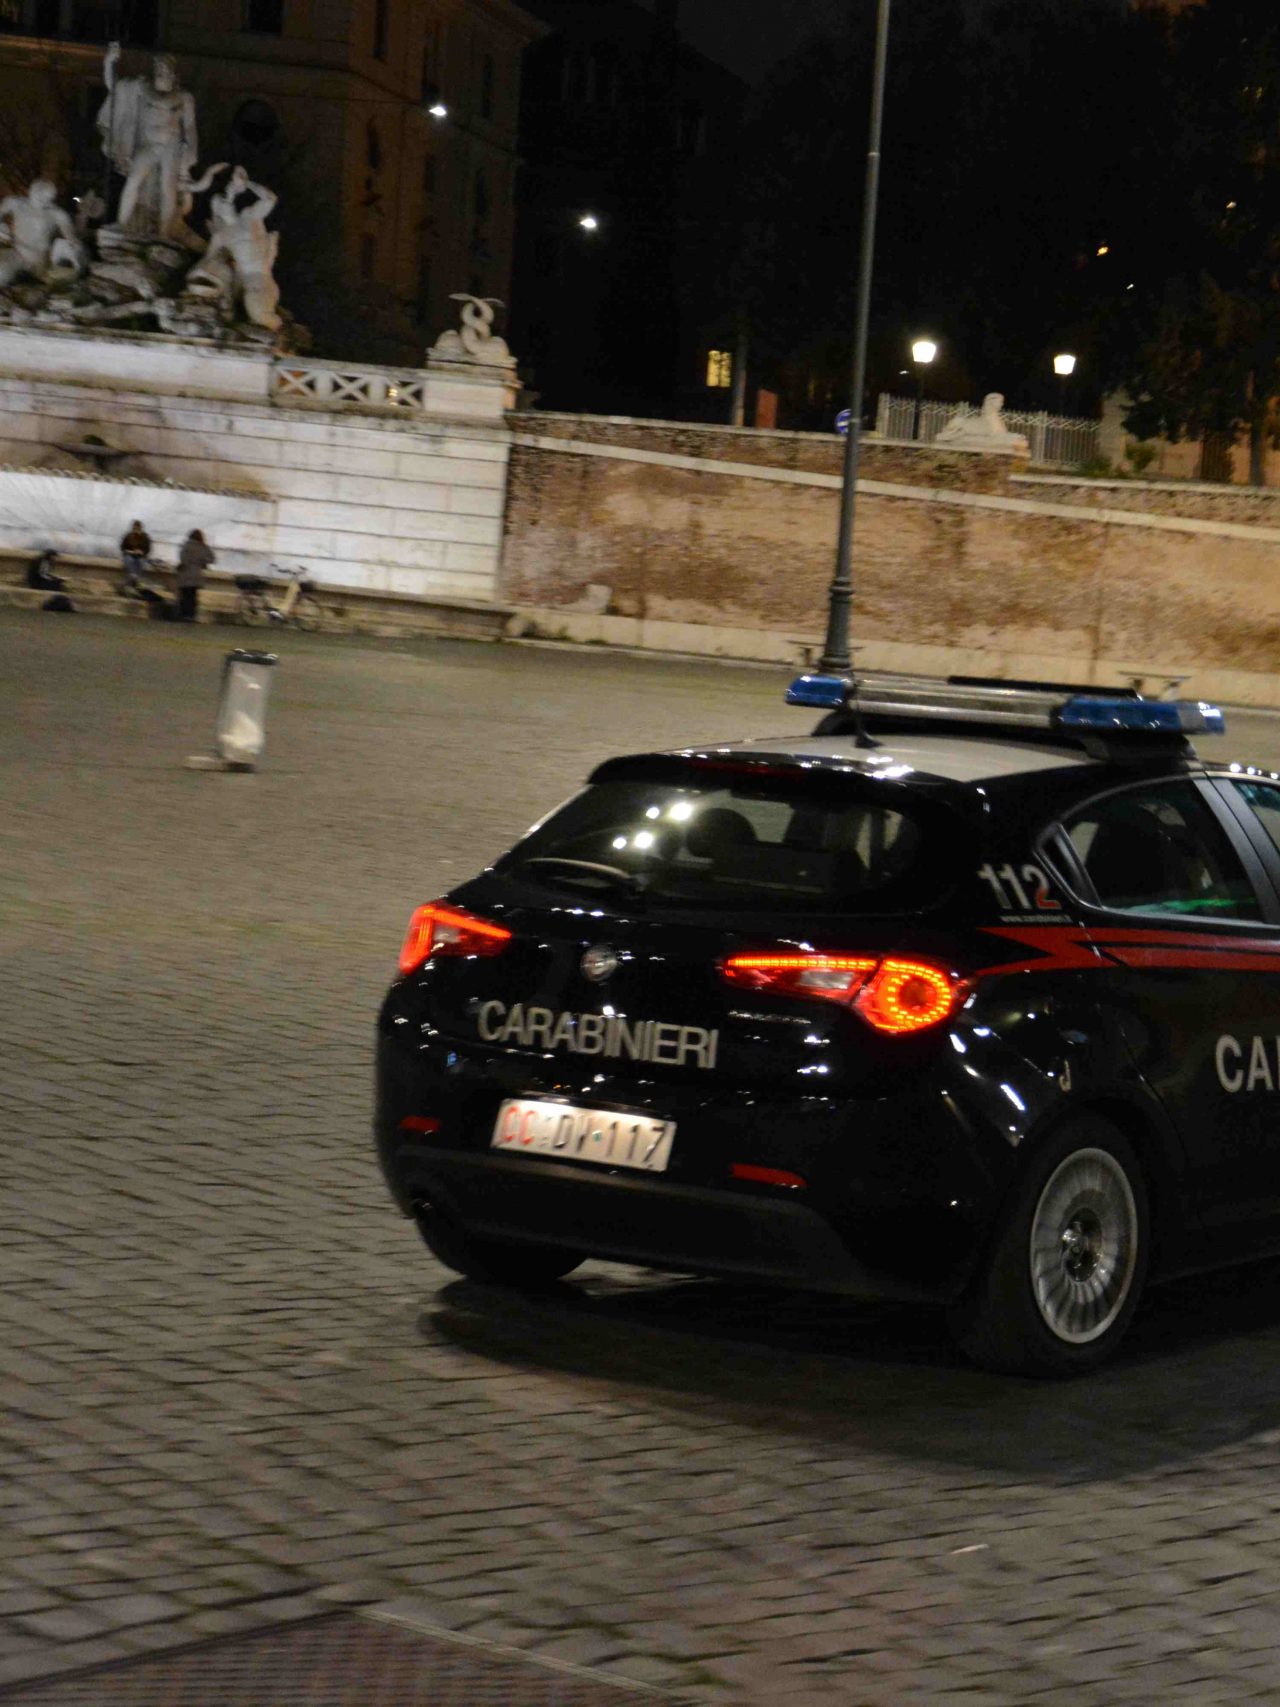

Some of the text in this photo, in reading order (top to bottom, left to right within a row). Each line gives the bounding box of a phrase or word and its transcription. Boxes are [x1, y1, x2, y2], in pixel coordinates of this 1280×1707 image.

[976, 863, 1061, 910] 112
[478, 1000, 719, 1068] CARABINIERI
[605, 1121, 666, 1163] 117
